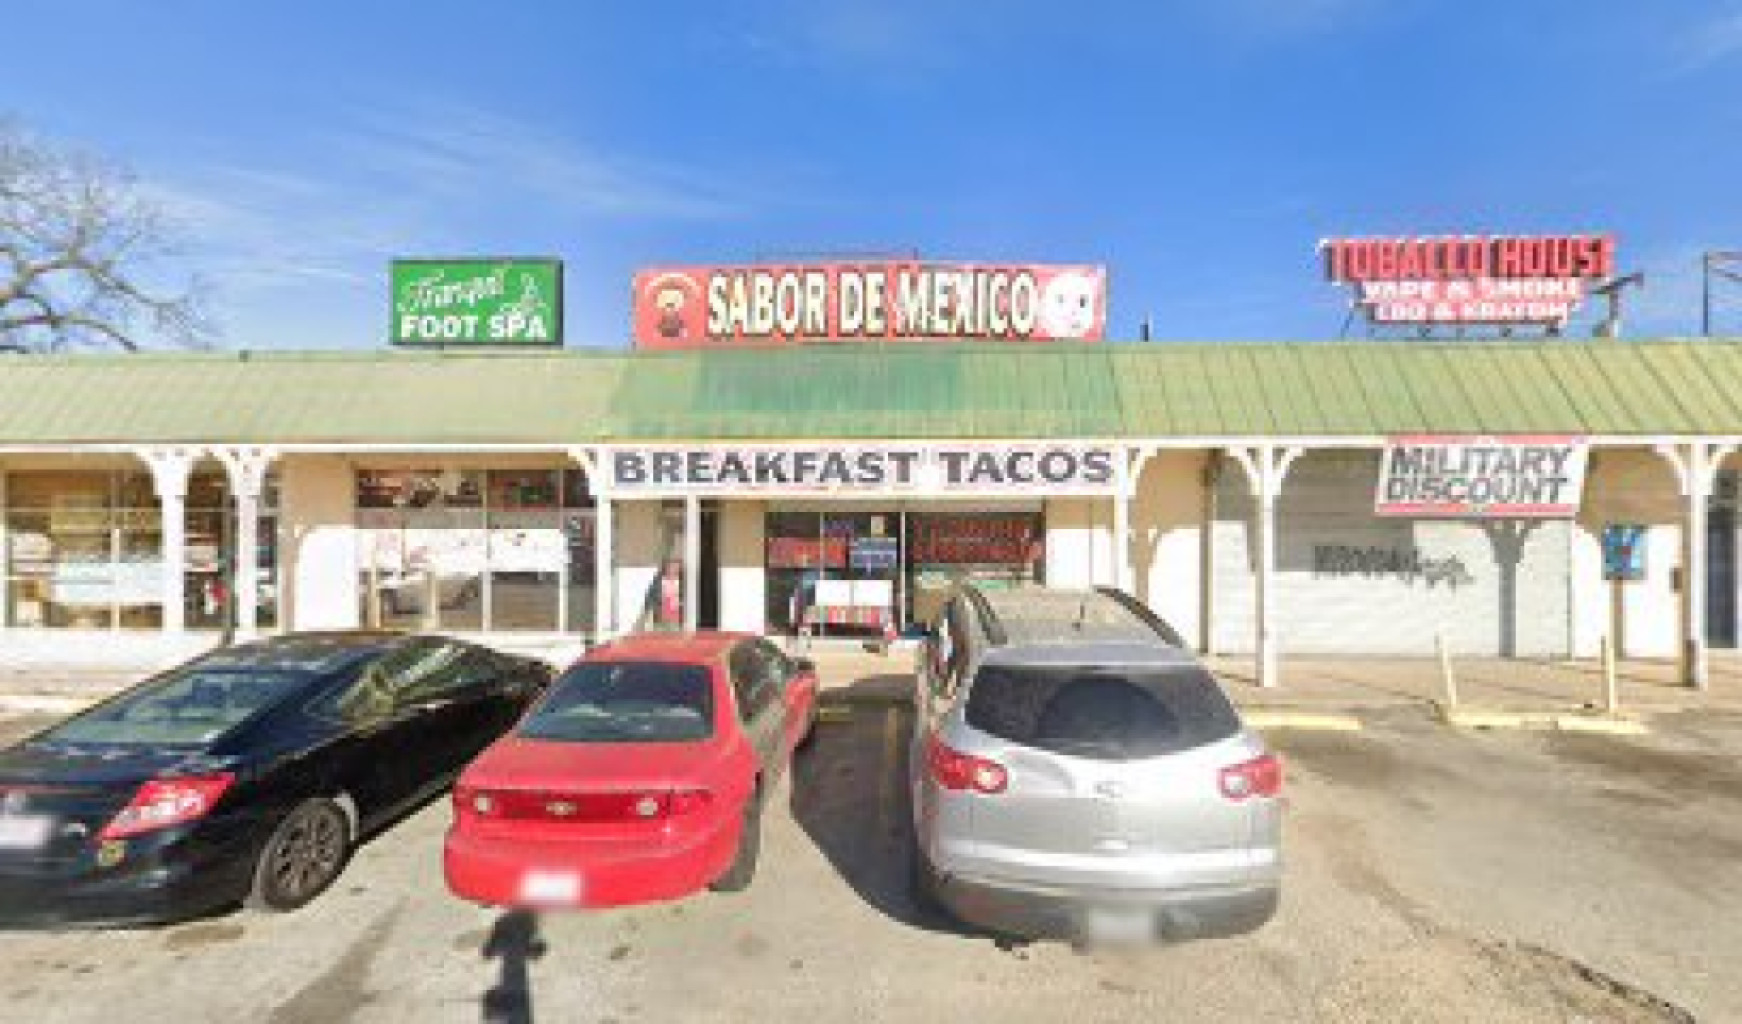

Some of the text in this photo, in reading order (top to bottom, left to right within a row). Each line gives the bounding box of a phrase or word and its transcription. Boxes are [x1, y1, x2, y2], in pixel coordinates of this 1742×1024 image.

[706, 268, 1037, 338] SABOR DE MEXICO
[400, 315, 547, 338] FOOT SPA
[613, 449, 1115, 485] BREAKFAST TACOS
[1391, 447, 1572, 475] MILITARY
[1386, 476, 1568, 504] DISCOUNT
